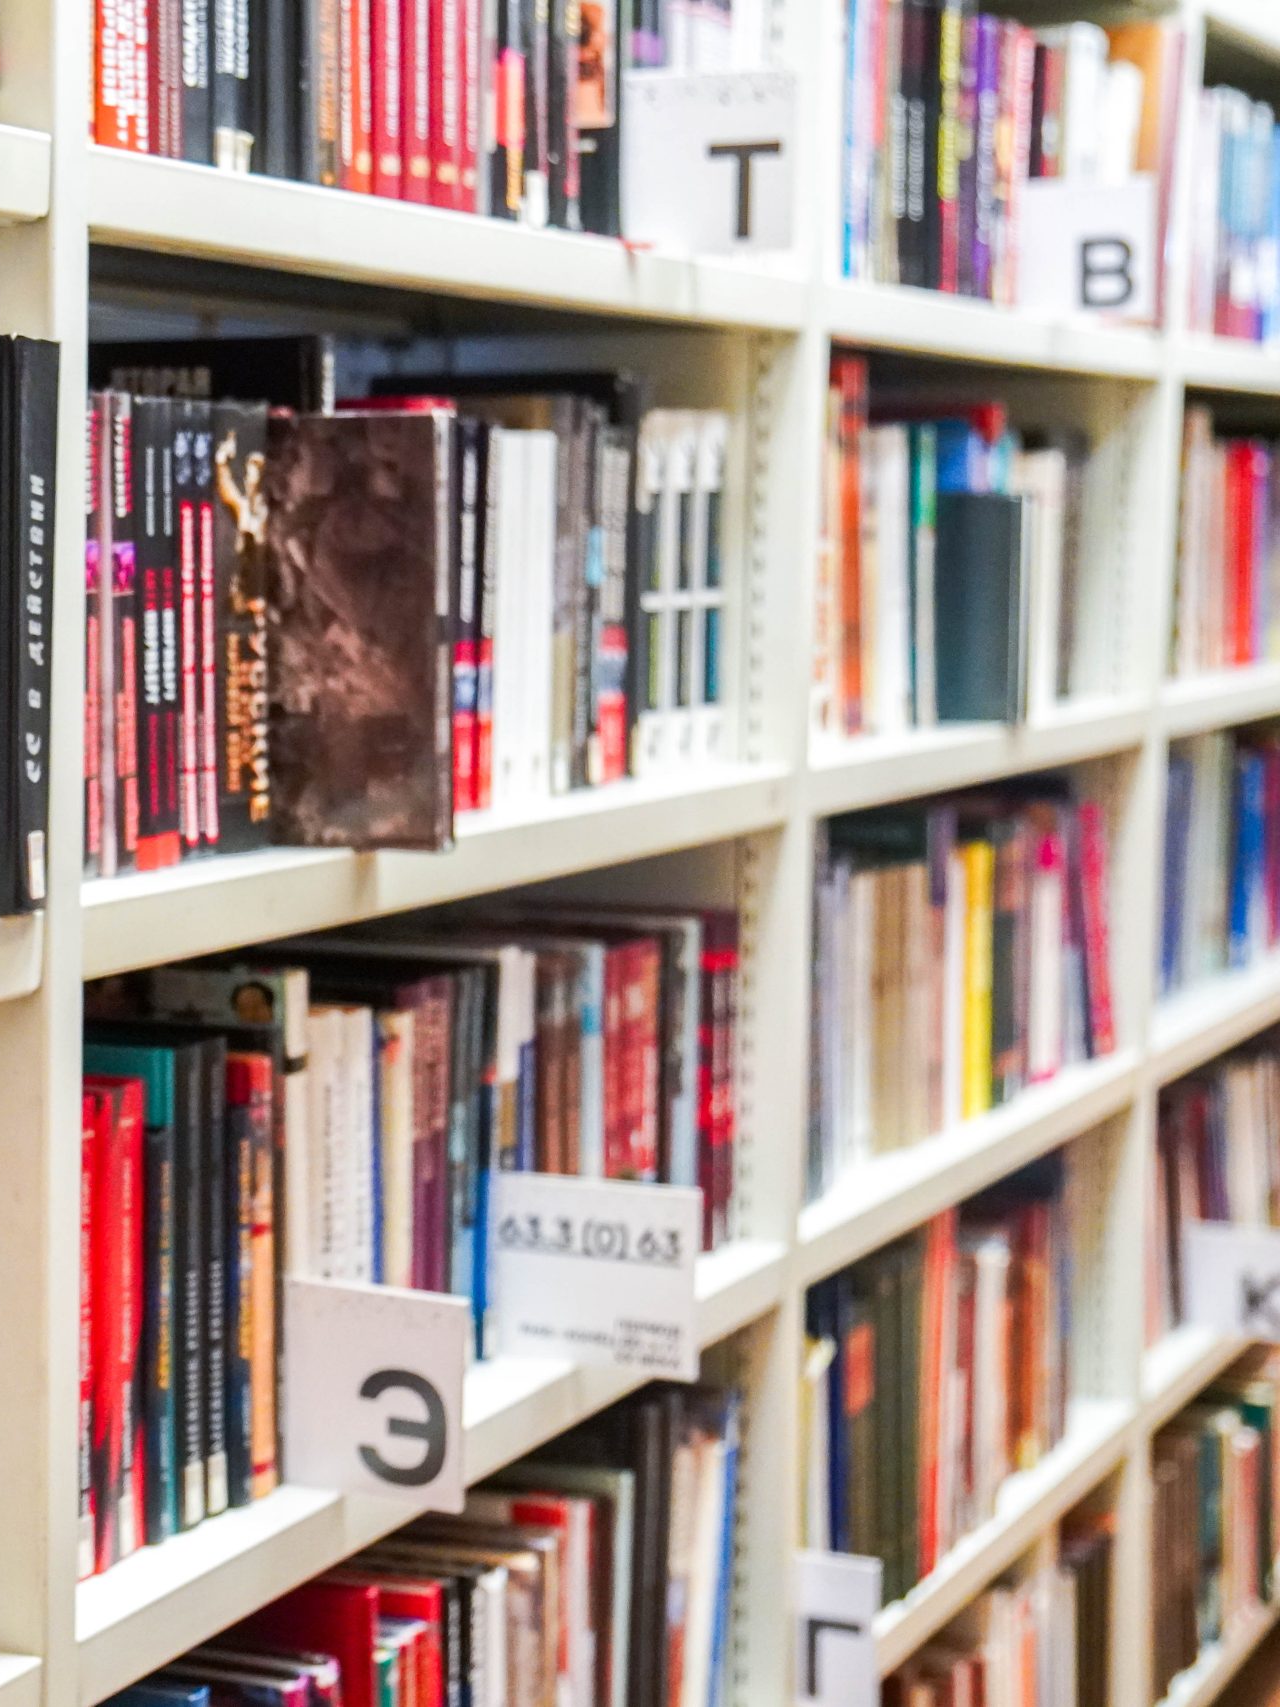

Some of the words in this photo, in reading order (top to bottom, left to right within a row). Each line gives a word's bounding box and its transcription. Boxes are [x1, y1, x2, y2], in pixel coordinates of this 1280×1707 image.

[709, 143, 780, 240] Т
[26, 474, 45, 666] ДЕЙСТВИИ
[358, 1368, 449, 1488] Э
